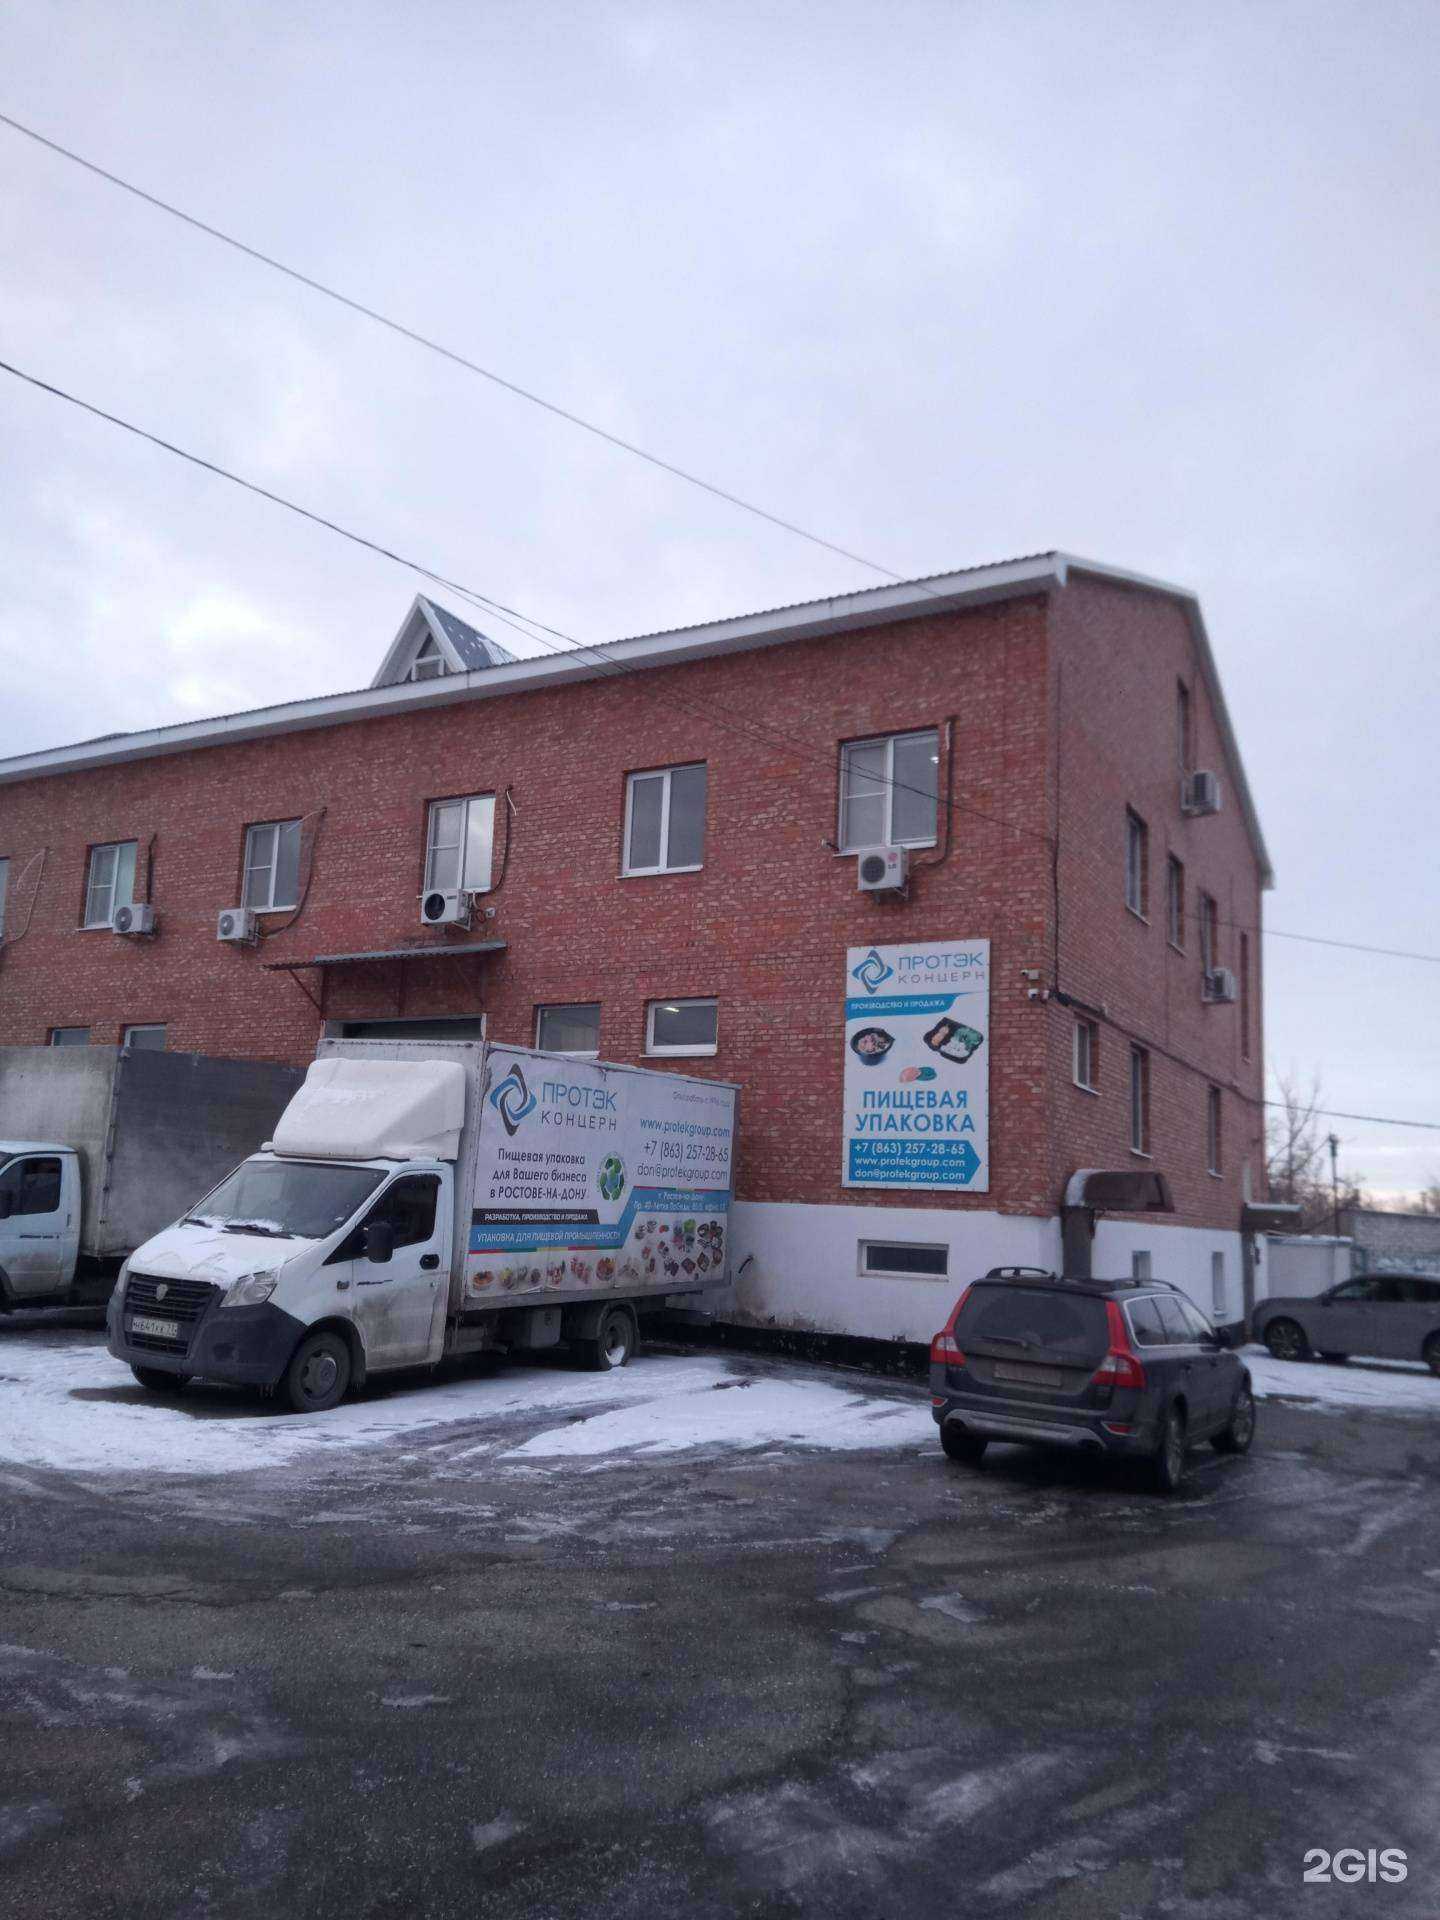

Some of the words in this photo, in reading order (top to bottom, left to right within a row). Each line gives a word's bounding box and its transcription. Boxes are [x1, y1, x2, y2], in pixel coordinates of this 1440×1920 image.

[898, 952, 983, 970] ПРОТЭК
[898, 971, 985, 984] КОНЦЕРН
[542, 1082, 617, 1111] ПРОТЭК
[863, 1090, 968, 1110] ПИЩЕВАЯ
[541, 1110, 617, 1131] КОНЦЕРН
[640, 1119, 730, 1137] www.protekgroup.com
[855, 1113, 975, 1132] УПАКОВКА
[498, 1148, 544, 1162] Пищевая
[545, 1153, 585, 1166] упаковка
[644, 1141, 657, 1157] +7
[660, 1142, 683, 1162] (863)
[686, 1144, 729, 1162] 257-28-65
[855, 1143, 868, 1154] +7
[872, 1142, 901, 1156] (863)
[905, 1143, 966, 1155] 257-28-65
[854, 1156, 966, 1168] www.protekgroup.com
[492, 1169, 510, 1180] для
[513, 1168, 549, 1181] Вашего
[551, 1169, 587, 1182] бизнеса
[637, 1162, 728, 1182] don@protekgroup.com
[854, 1168, 966, 1181] don@protekgroup.com
[490, 1188, 496, 1198] в
[498, 1186, 587, 1200] РОСТОВЕ-НА-ДОНУ
[477, 1232, 515, 1242] УПАКОВКА
[516, 1232, 531, 1243] ДЛЯ
[532, 1231, 563, 1241] ПИЩЕВОЙ
